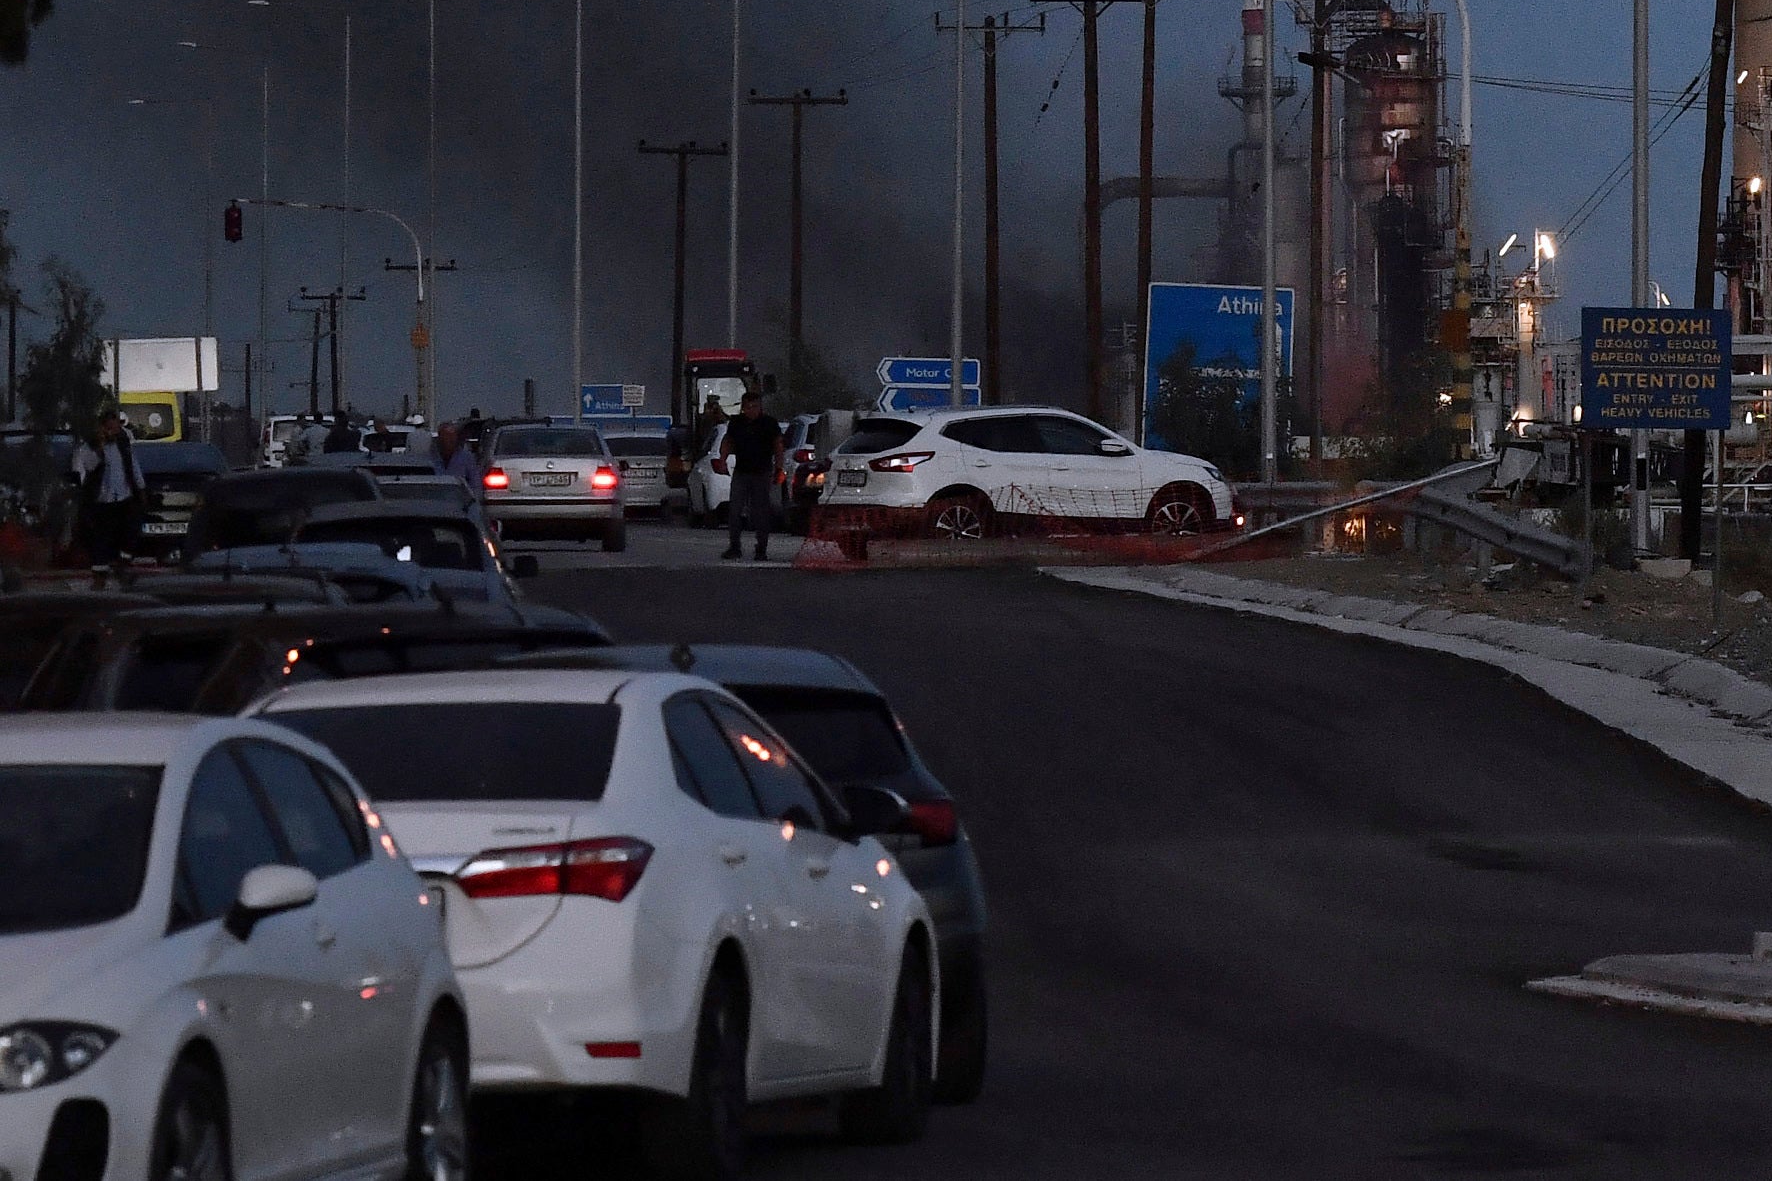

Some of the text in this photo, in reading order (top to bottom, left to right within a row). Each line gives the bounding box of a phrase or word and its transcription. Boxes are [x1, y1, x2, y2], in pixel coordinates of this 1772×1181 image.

[1217, 295, 1283, 316] Athia
[1602, 318, 1711, 335] ΠΡΟΣΟΧΗ!
[1595, 339, 1650, 349] ΕΙΣΟΔΟΣ
[1667, 339, 1719, 350] ΕΞΟΔΟΣ
[1591, 351, 1721, 364] ΒΑΡΕΩΝ ΟΧΗΜΑΤΩΝ
[905, 367, 940, 378] Motor
[1597, 373, 1716, 388] ATTENTION
[1613, 394, 1653, 404] ENTRY
[1671, 394, 1699, 404] EXIT
[1601, 407, 1711, 419] HEAVY VEHICLES
